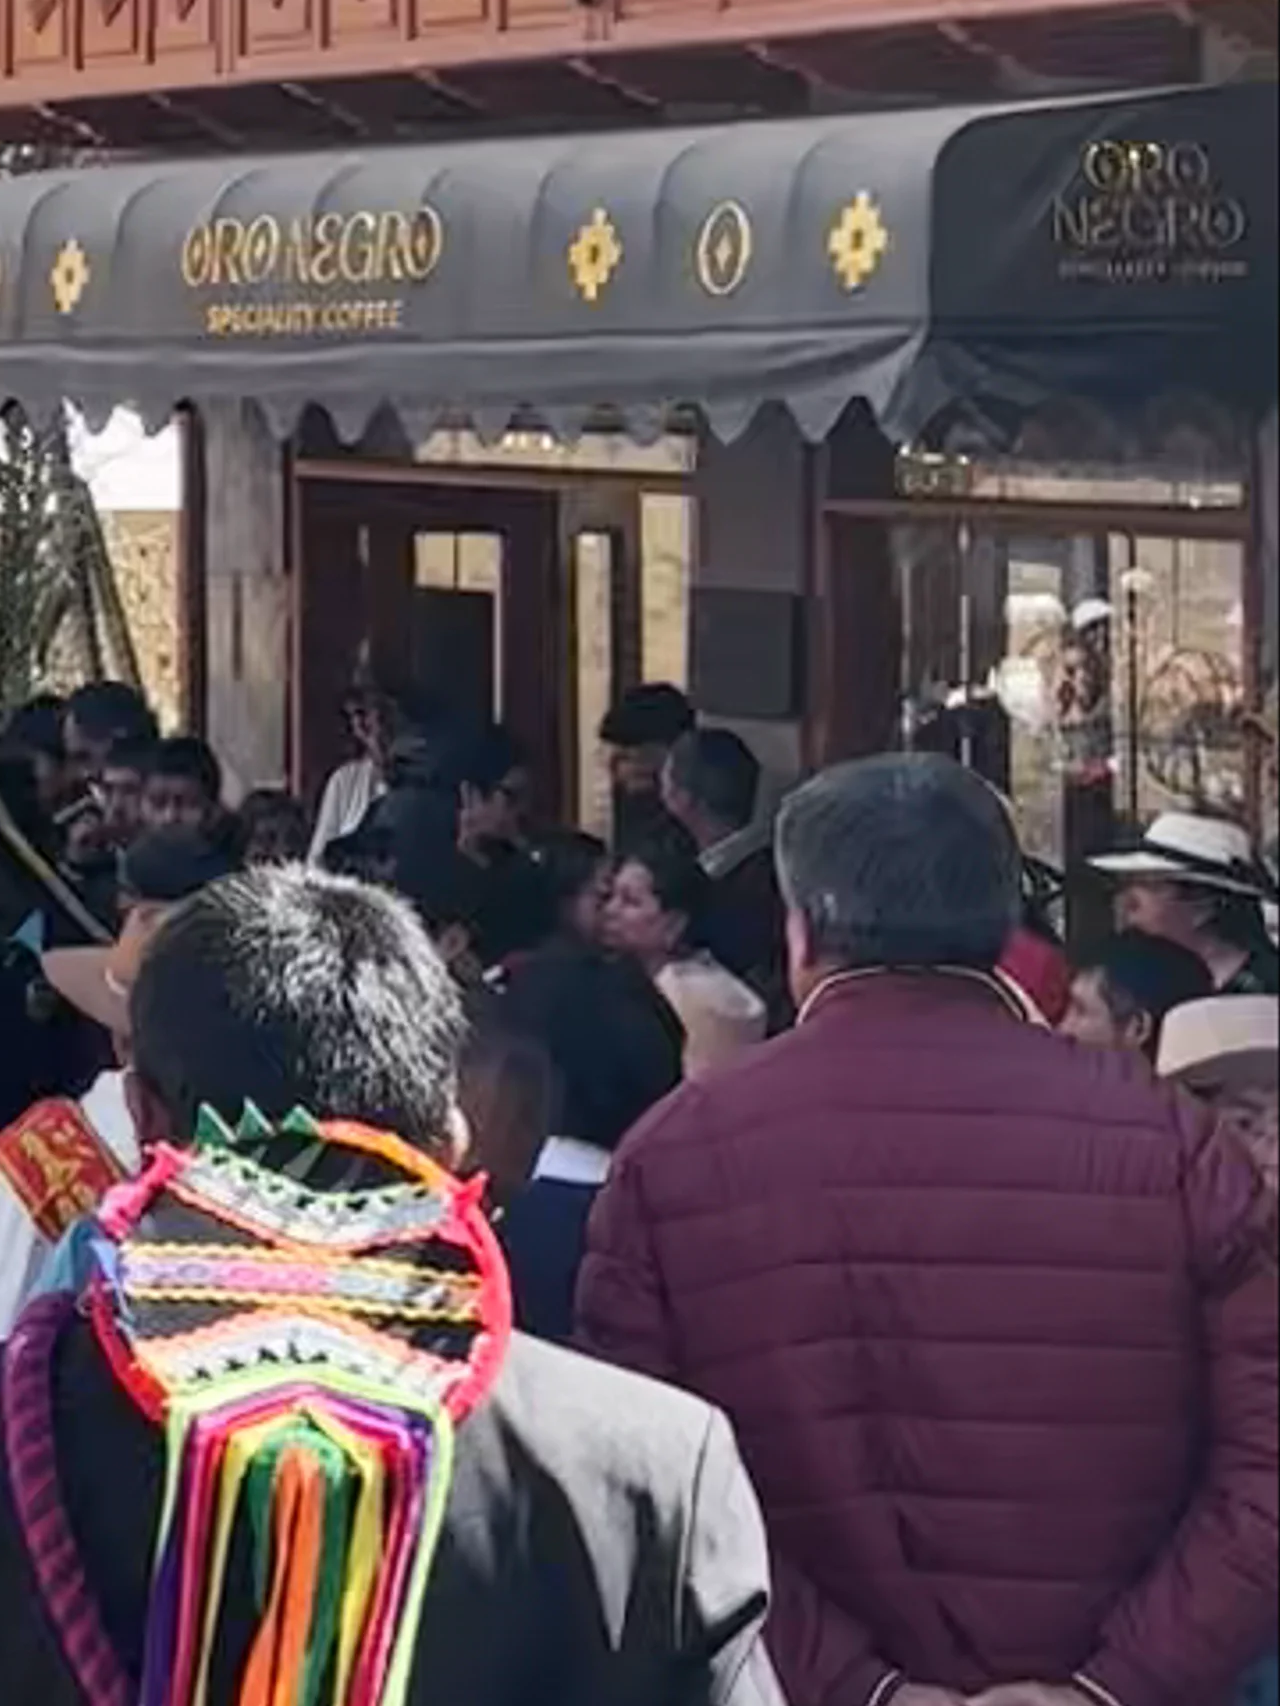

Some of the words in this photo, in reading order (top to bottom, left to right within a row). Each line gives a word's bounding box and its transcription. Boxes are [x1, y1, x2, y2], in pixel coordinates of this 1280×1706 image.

[1083, 140, 1209, 190] ORO
[181, 213, 281, 286] ORO
[286, 205, 442, 284] NEGRO
[1051, 195, 1245, 248] NEGRO
[320, 297, 404, 329] COFFEE
